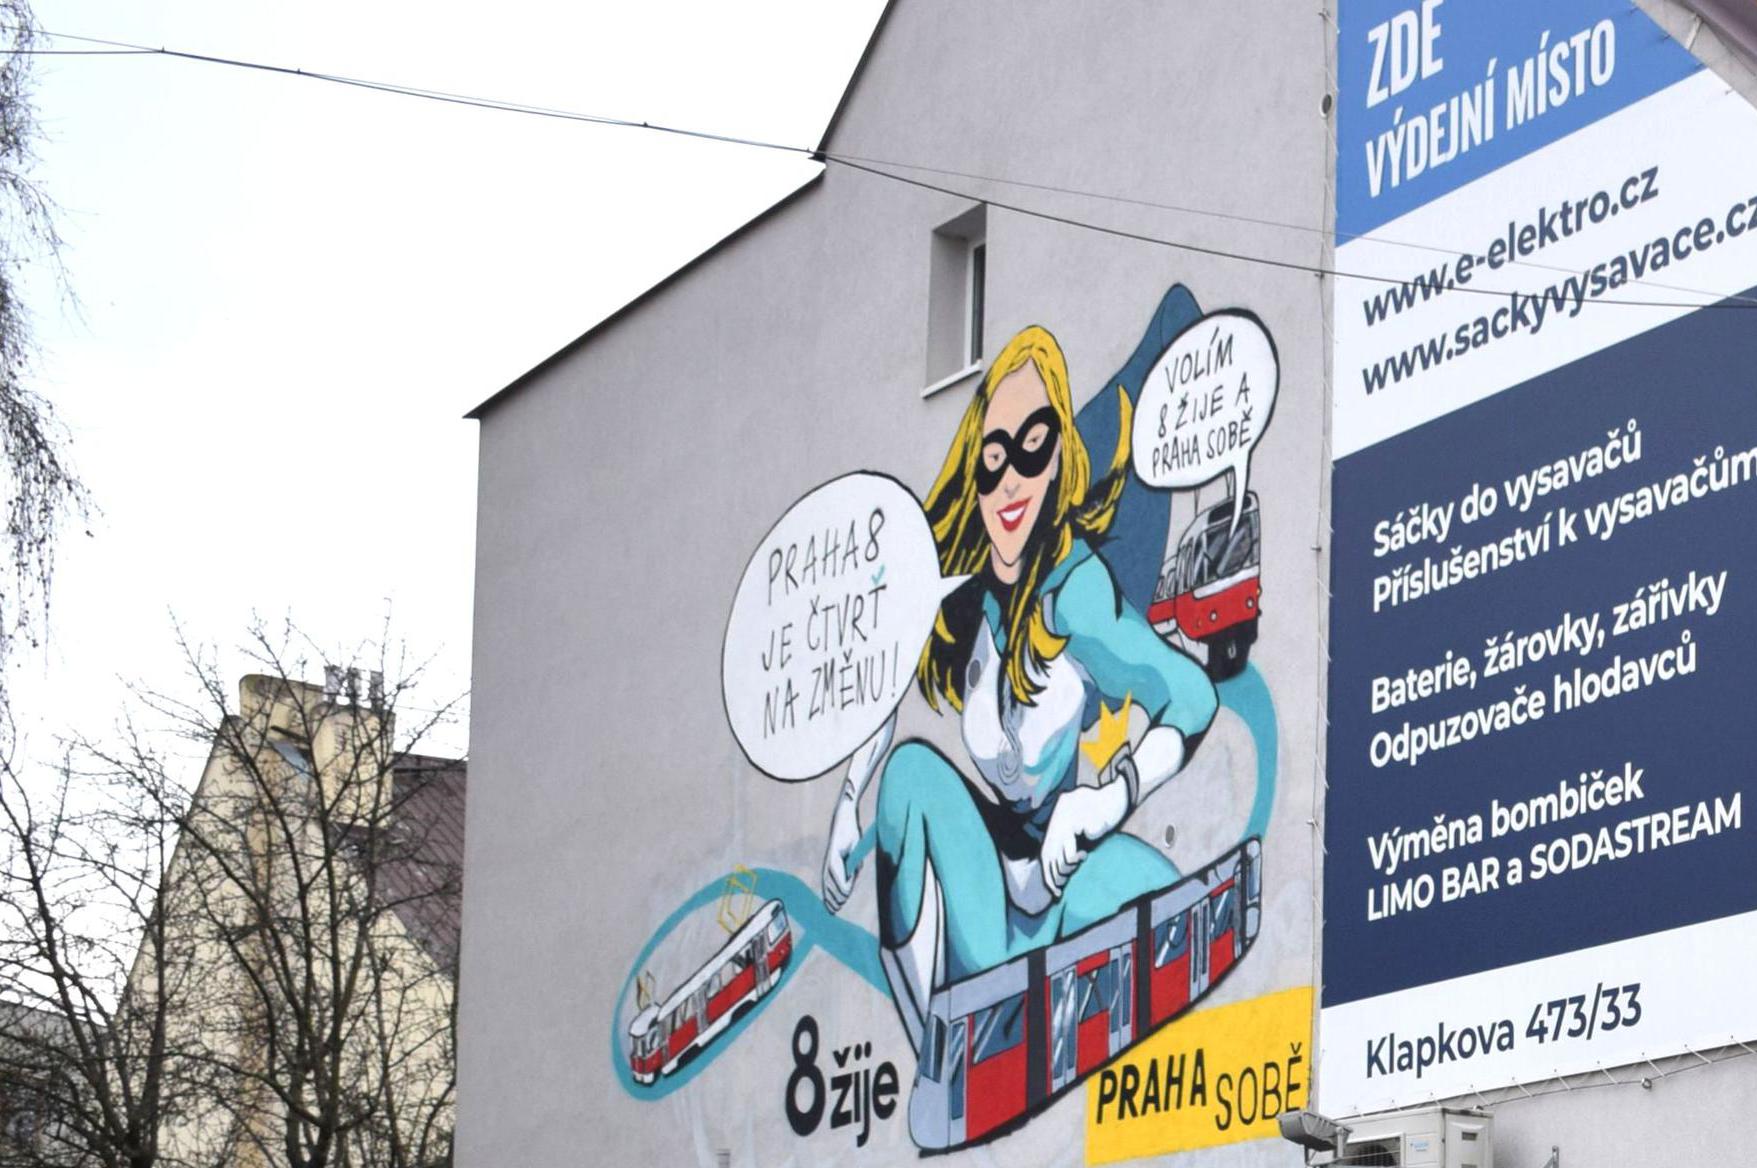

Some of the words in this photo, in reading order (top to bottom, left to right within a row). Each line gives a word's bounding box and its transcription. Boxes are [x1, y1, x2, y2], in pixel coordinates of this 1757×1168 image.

[1365, 57, 1498, 198] VÝDEJNÍ
[1505, 18, 1616, 130] MÍSTO
[1366, 0, 1444, 109] ZDE
[1362, 166, 1660, 327] www.e-elektro.cz
[1158, 401, 1170, 439] 8
[1174, 385, 1225, 433] ŽIJE
[1235, 371, 1251, 410] A
[1165, 327, 1235, 394] VOLÍM
[1151, 437, 1201, 479] PRAHA
[1206, 408, 1253, 462] SOBĚ
[1373, 499, 1455, 558] Sáčky
[1461, 482, 1498, 525] do
[1504, 418, 1643, 512] vysavačů
[1373, 513, 1553, 613] Příslušenství
[1558, 512, 1578, 547] k
[762, 621, 792, 672] JE
[1370, 648, 1477, 714] Baterie,
[1484, 610, 1605, 682] žárovky,
[1612, 571, 1728, 638] zářivky
[764, 683, 800, 738] NA
[1369, 689, 1546, 768] Odpuzovače
[1554, 630, 1697, 713] hlodavců
[1367, 810, 1484, 875] Výměna
[1490, 761, 1645, 837] bombiček
[1367, 875, 1435, 922] LIMO
[1443, 861, 1500, 903] BAR
[1506, 861, 1523, 885] a
[1530, 792, 1743, 882] SODASTREAM
[785, 1015, 827, 1136] 8
[830, 1042, 899, 1147] žije
[1365, 1017, 1516, 1079] Klapkova
[1525, 982, 1643, 1048] 473/33
[1097, 1048, 1207, 1123] PRAHA
[1214, 1042, 1302, 1132] SOBĚ
